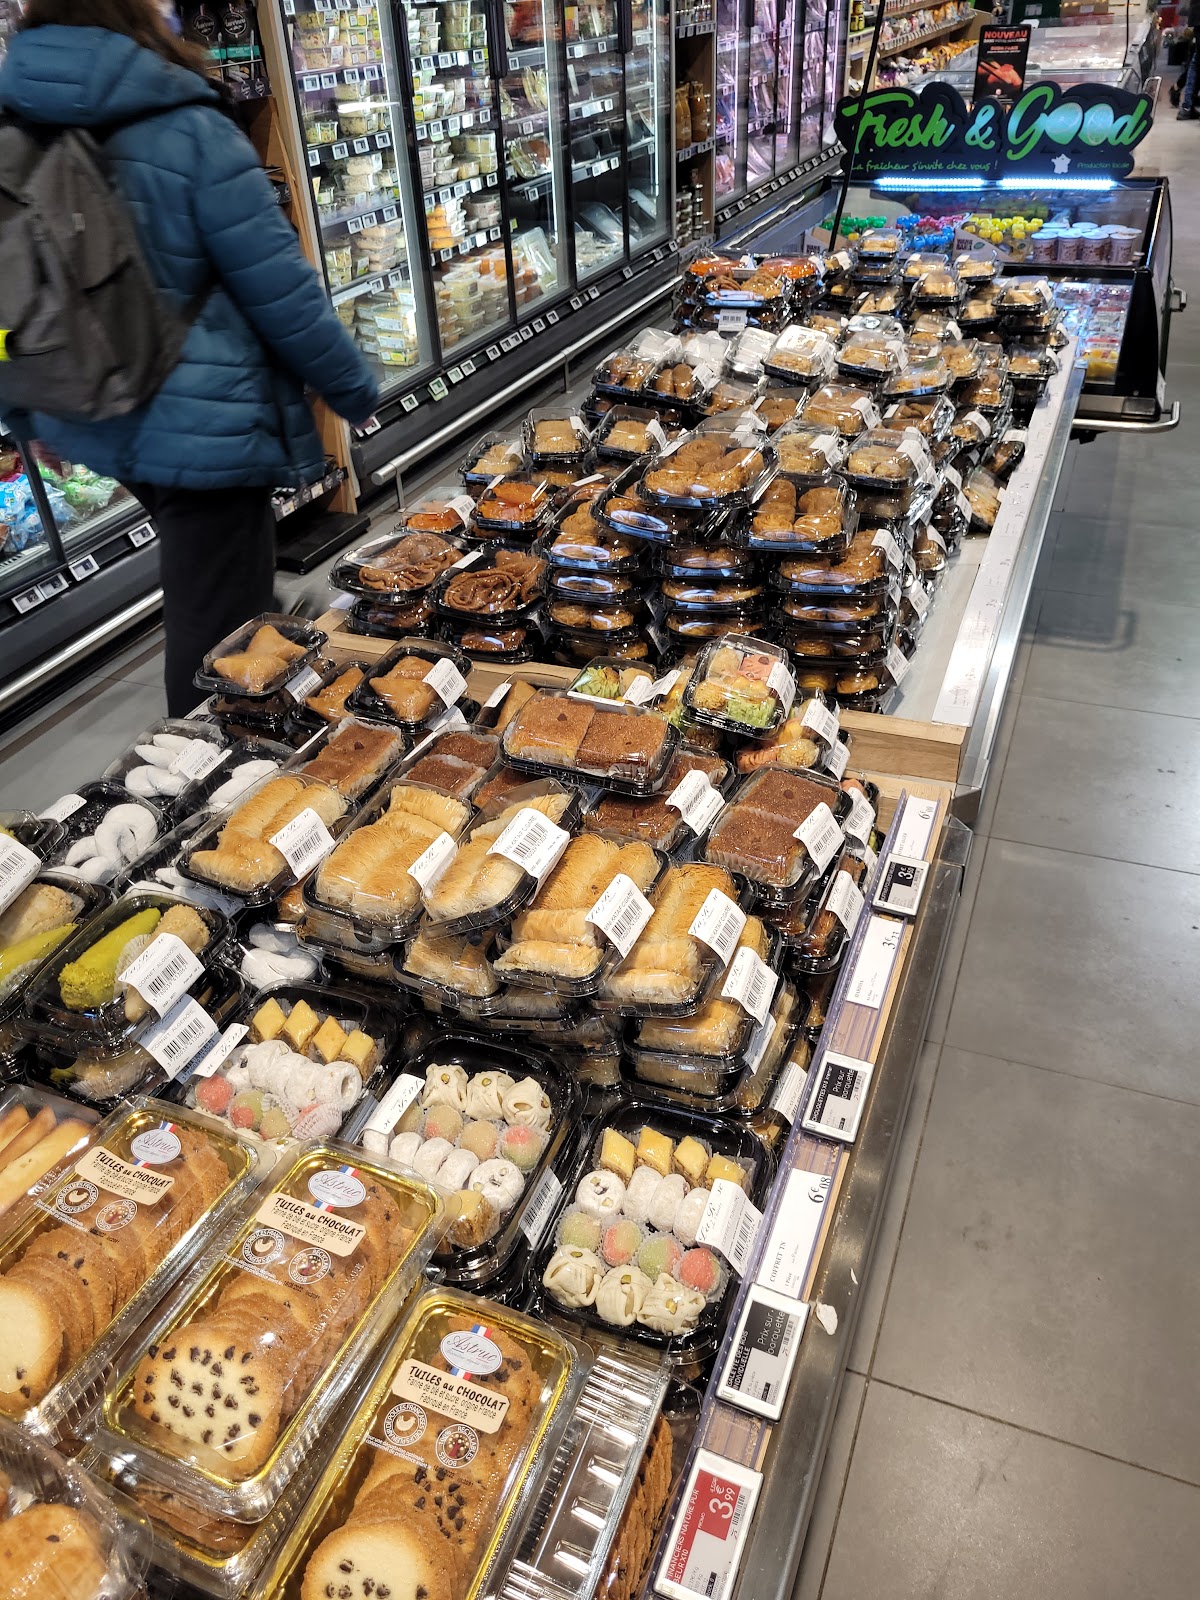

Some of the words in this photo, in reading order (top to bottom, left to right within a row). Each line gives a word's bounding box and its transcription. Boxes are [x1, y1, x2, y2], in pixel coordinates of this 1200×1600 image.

[984, 30, 1027, 39] NOUVEAU
[842, 93, 955, 154] Fresh
[965, 105, 995, 149] &
[1007, 86, 1147, 160] Good
[832, 1080, 842, 1092] Prix
[837, 1069, 845, 1080] sur
[138, 1131, 178, 1153] Astruc
[95, 1151, 123, 1173] TUILES
[122, 1168, 131, 1176] au
[132, 1168, 172, 1189] CHOCOLAT
[315, 1173, 361, 1198] Astruc
[274, 1196, 304, 1215] TUILES
[304, 1210, 316, 1220] au
[316, 1214, 363, 1239] CHOCOLAT
[769, 1252, 782, 1282] COFFRET
[778, 1240, 786, 1250] TN
[739, 1329, 748, 1345] ROIS
[756, 1327, 769, 1344] Prix
[763, 1312, 774, 1327] sur
[766, 1310, 786, 1355] barquette
[447, 1334, 497, 1361] Astruc
[735, 1344, 744, 1358] DES
[726, 1358, 740, 1387] GALETTE
[732, 1346, 750, 1389] INDIVIDUELLE
[406, 1374, 424, 1390] Farine
[422, 1381, 431, 1392] de
[458, 1397, 479, 1414] origine
[477, 1404, 497, 1419] France
[408, 1364, 442, 1386] TUILES
[442, 1381, 455, 1392] au
[455, 1384, 506, 1412] CHOCOLAT
[448, 1403, 469, 1420] France
[680, 1503, 695, 1535] NATURE
[689, 1488, 699, 1504] PUR
[697, 1511, 705, 1528] PROMO
[679, 1547, 689, 1562] X10
